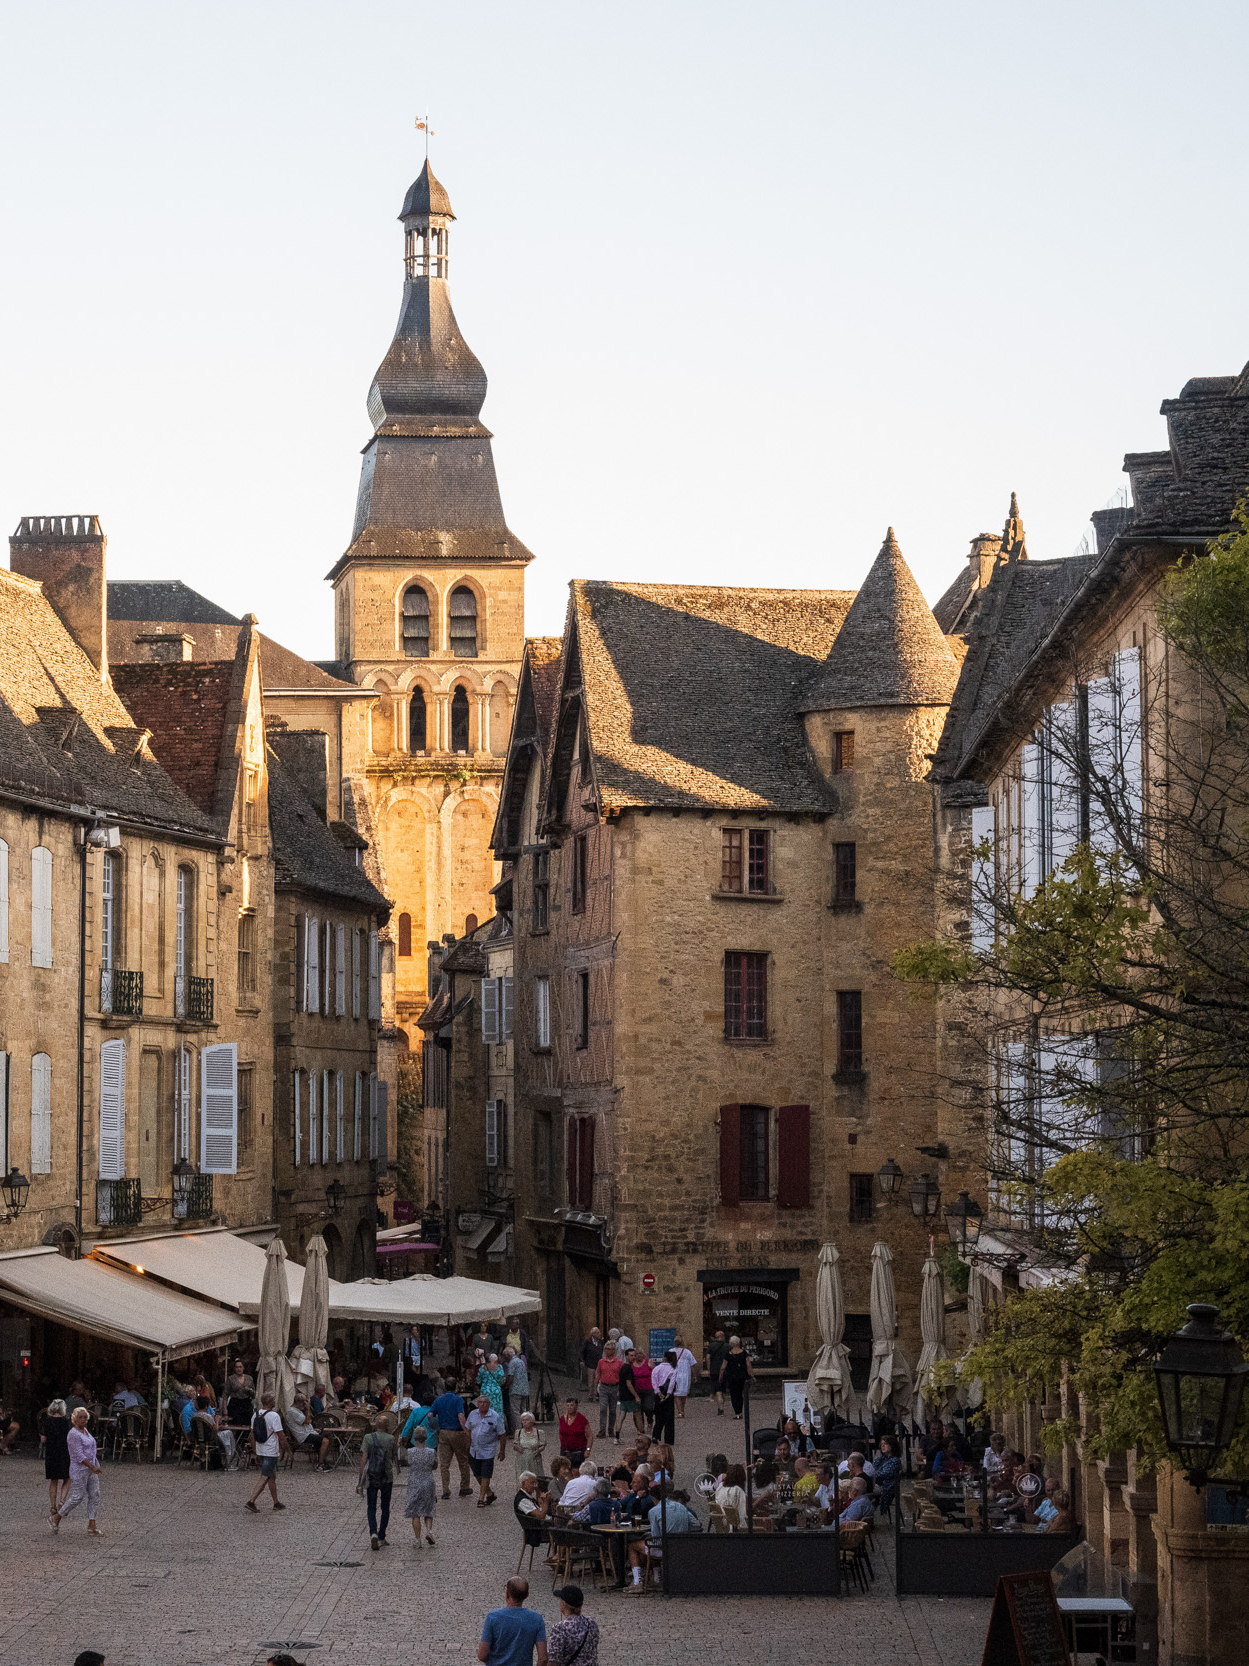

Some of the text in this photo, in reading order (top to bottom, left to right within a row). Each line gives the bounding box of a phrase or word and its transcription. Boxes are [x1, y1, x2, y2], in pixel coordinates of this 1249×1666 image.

[738, 1255, 770, 1267] GRAS
[708, 1288, 717, 1298] LA
[716, 1285, 739, 1295] TRUFFE
[739, 1285, 749, 1293] DU
[749, 1285, 779, 1301] PERIGORD
[715, 1308, 770, 1317] VENTE DIRECTE
